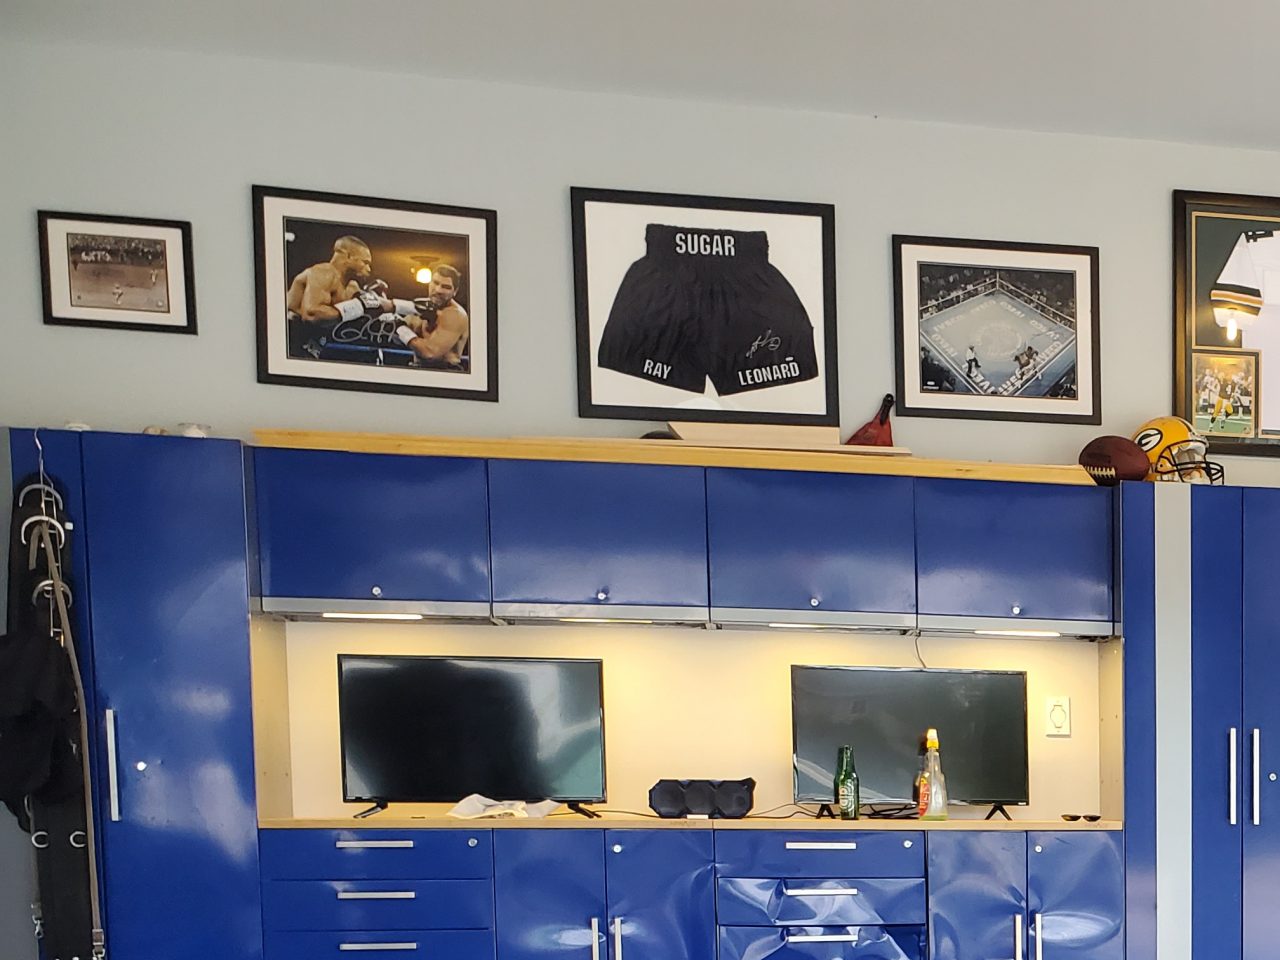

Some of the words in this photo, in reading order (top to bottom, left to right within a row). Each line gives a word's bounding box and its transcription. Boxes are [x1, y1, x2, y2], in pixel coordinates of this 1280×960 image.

[675, 232, 735, 256] SUGAR
[643, 359, 672, 380] RAY
[738, 361, 800, 386] LEONARD
